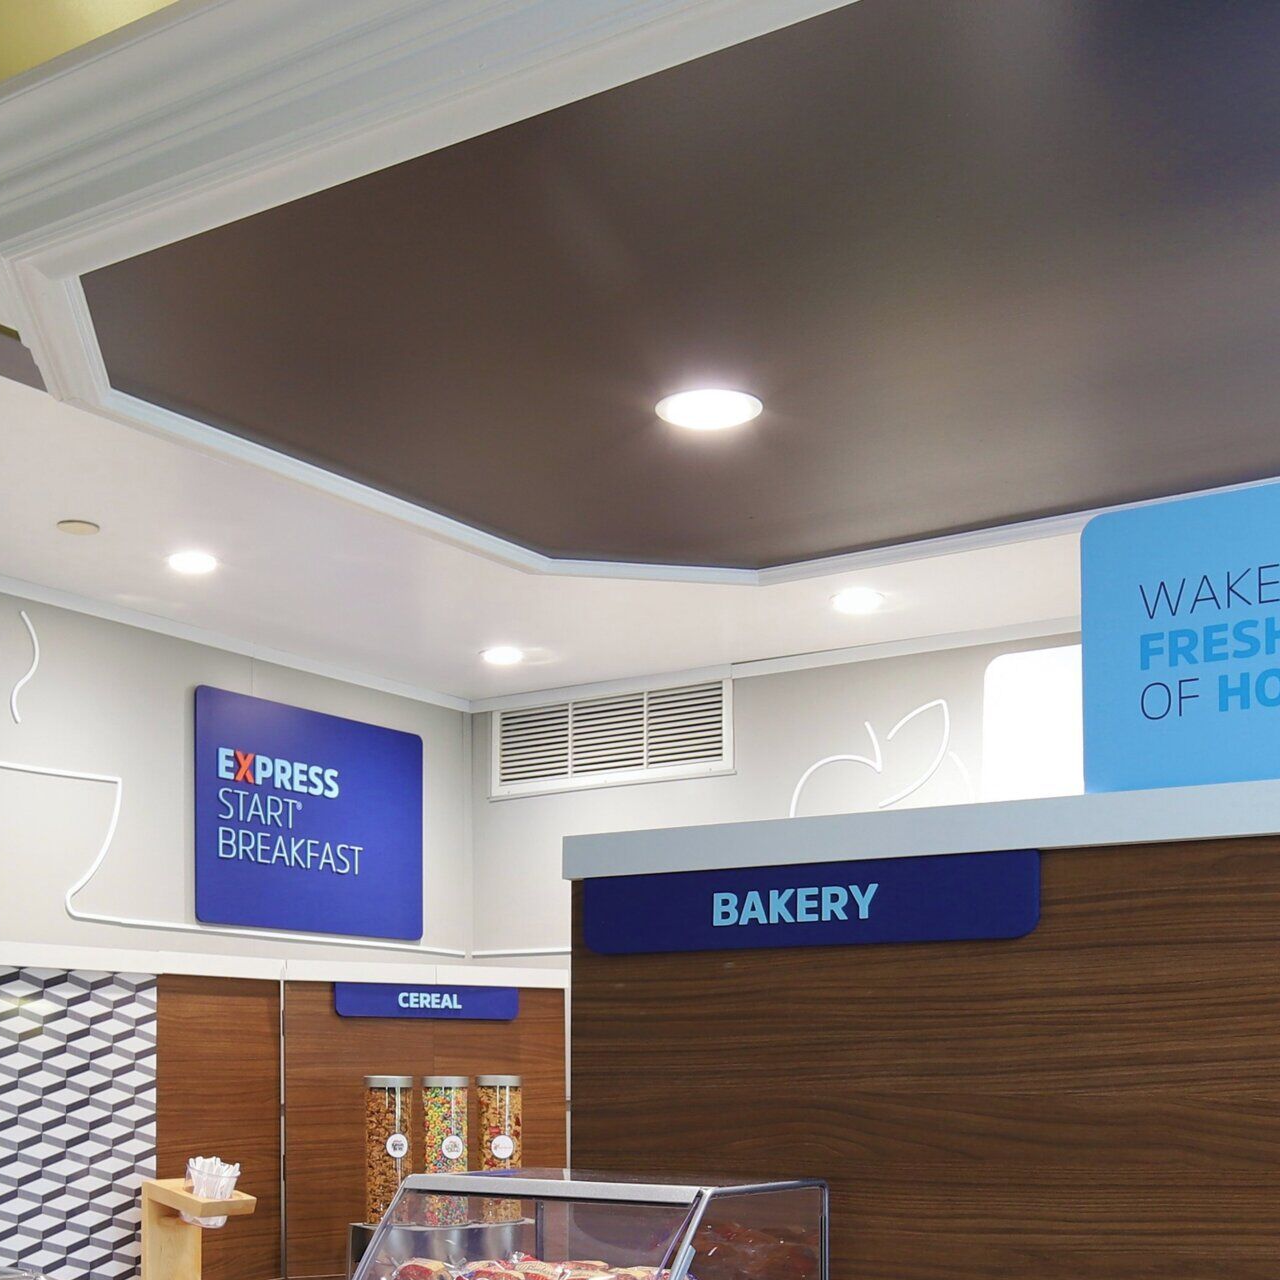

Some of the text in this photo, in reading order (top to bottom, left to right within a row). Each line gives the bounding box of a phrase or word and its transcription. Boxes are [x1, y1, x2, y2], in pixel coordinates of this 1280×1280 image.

[1138, 563, 1280, 620] WAKE
[1139, 678, 1201, 721] OF
[216, 746, 340, 800] EXPRESS
[217, 826, 364, 876] BREAKFAST
[712, 882, 879, 927] BAKERY
[397, 991, 463, 1011] CEREAL
